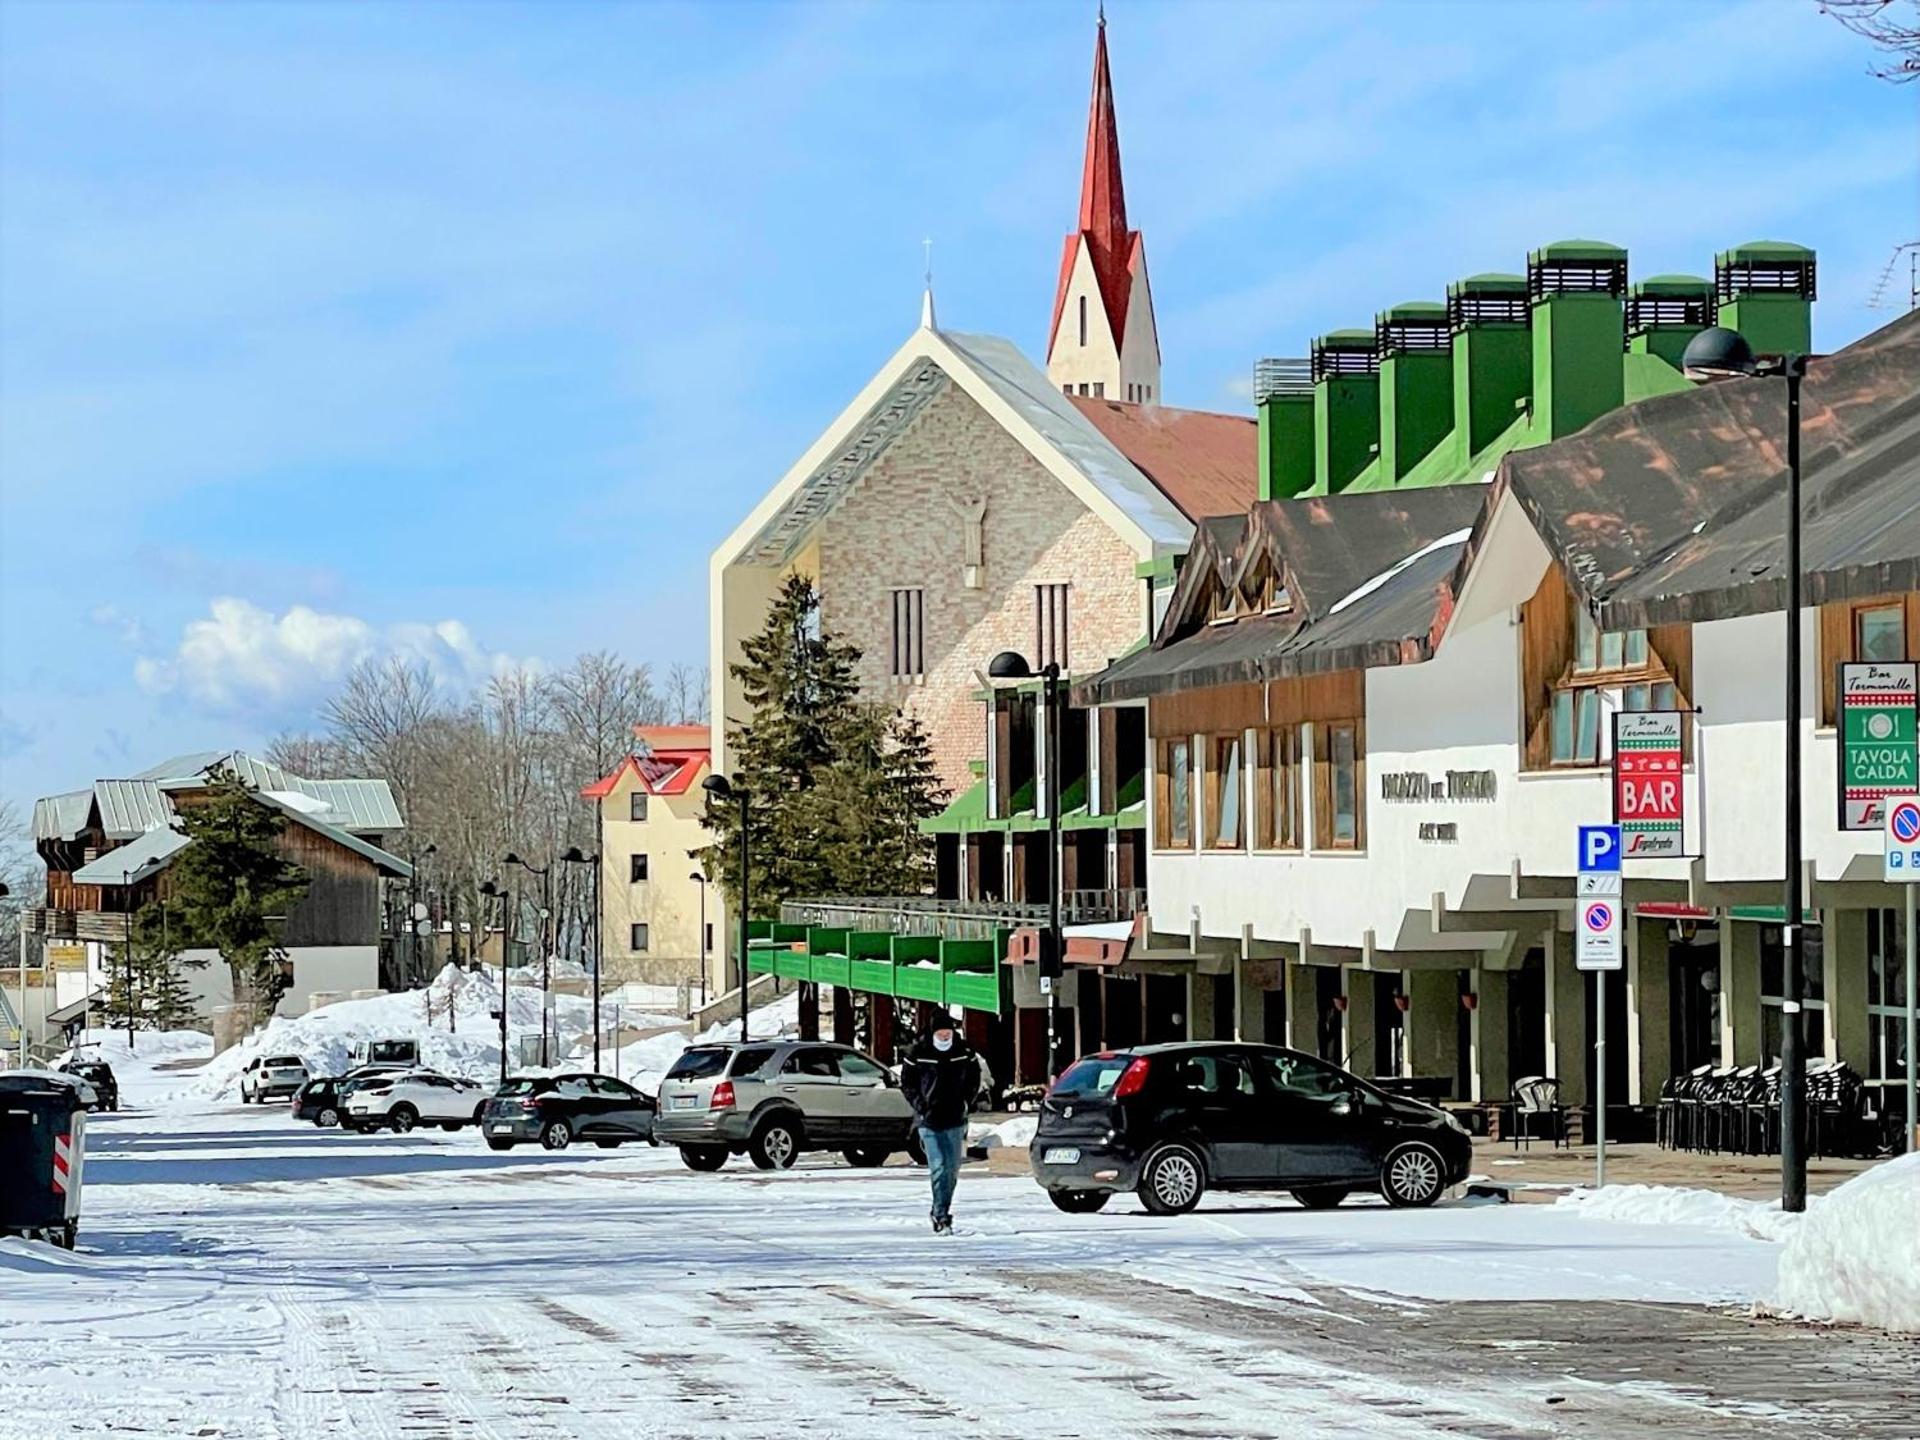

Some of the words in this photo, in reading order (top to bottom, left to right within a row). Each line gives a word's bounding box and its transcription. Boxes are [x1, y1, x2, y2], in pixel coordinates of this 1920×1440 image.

[1867, 666, 1891, 678] Bar
[1850, 749, 1911, 764] TAVOLA
[1855, 765, 1908, 779] CALDA
[1622, 781, 1677, 813] BAR
[1587, 831, 1612, 867] P
